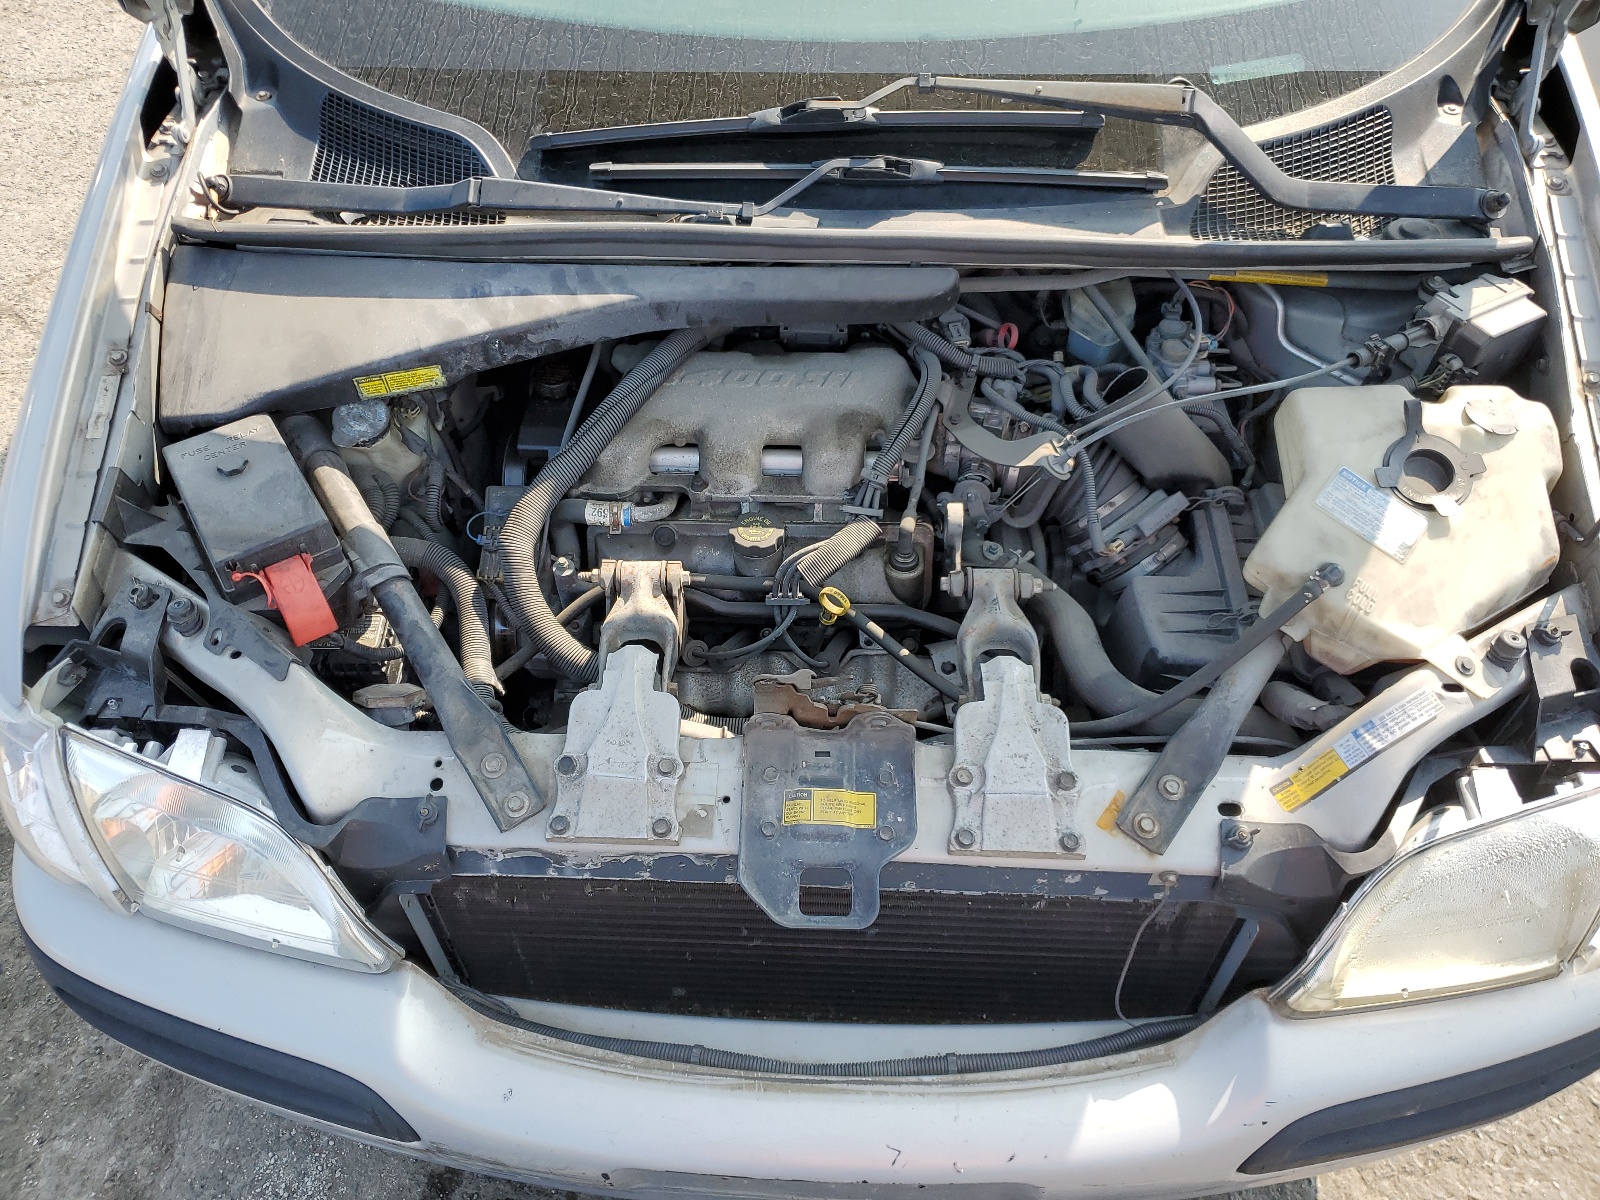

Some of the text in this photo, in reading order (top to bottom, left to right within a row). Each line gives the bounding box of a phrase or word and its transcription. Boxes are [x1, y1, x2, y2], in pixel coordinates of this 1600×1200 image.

[180, 425, 261, 460] FUSE RELAY
[203, 441, 247, 461] CENTER
[1342, 471, 1367, 490] NOTICE
[1345, 588, 1376, 615] COLD
[1352, 576, 1379, 602] FULL
